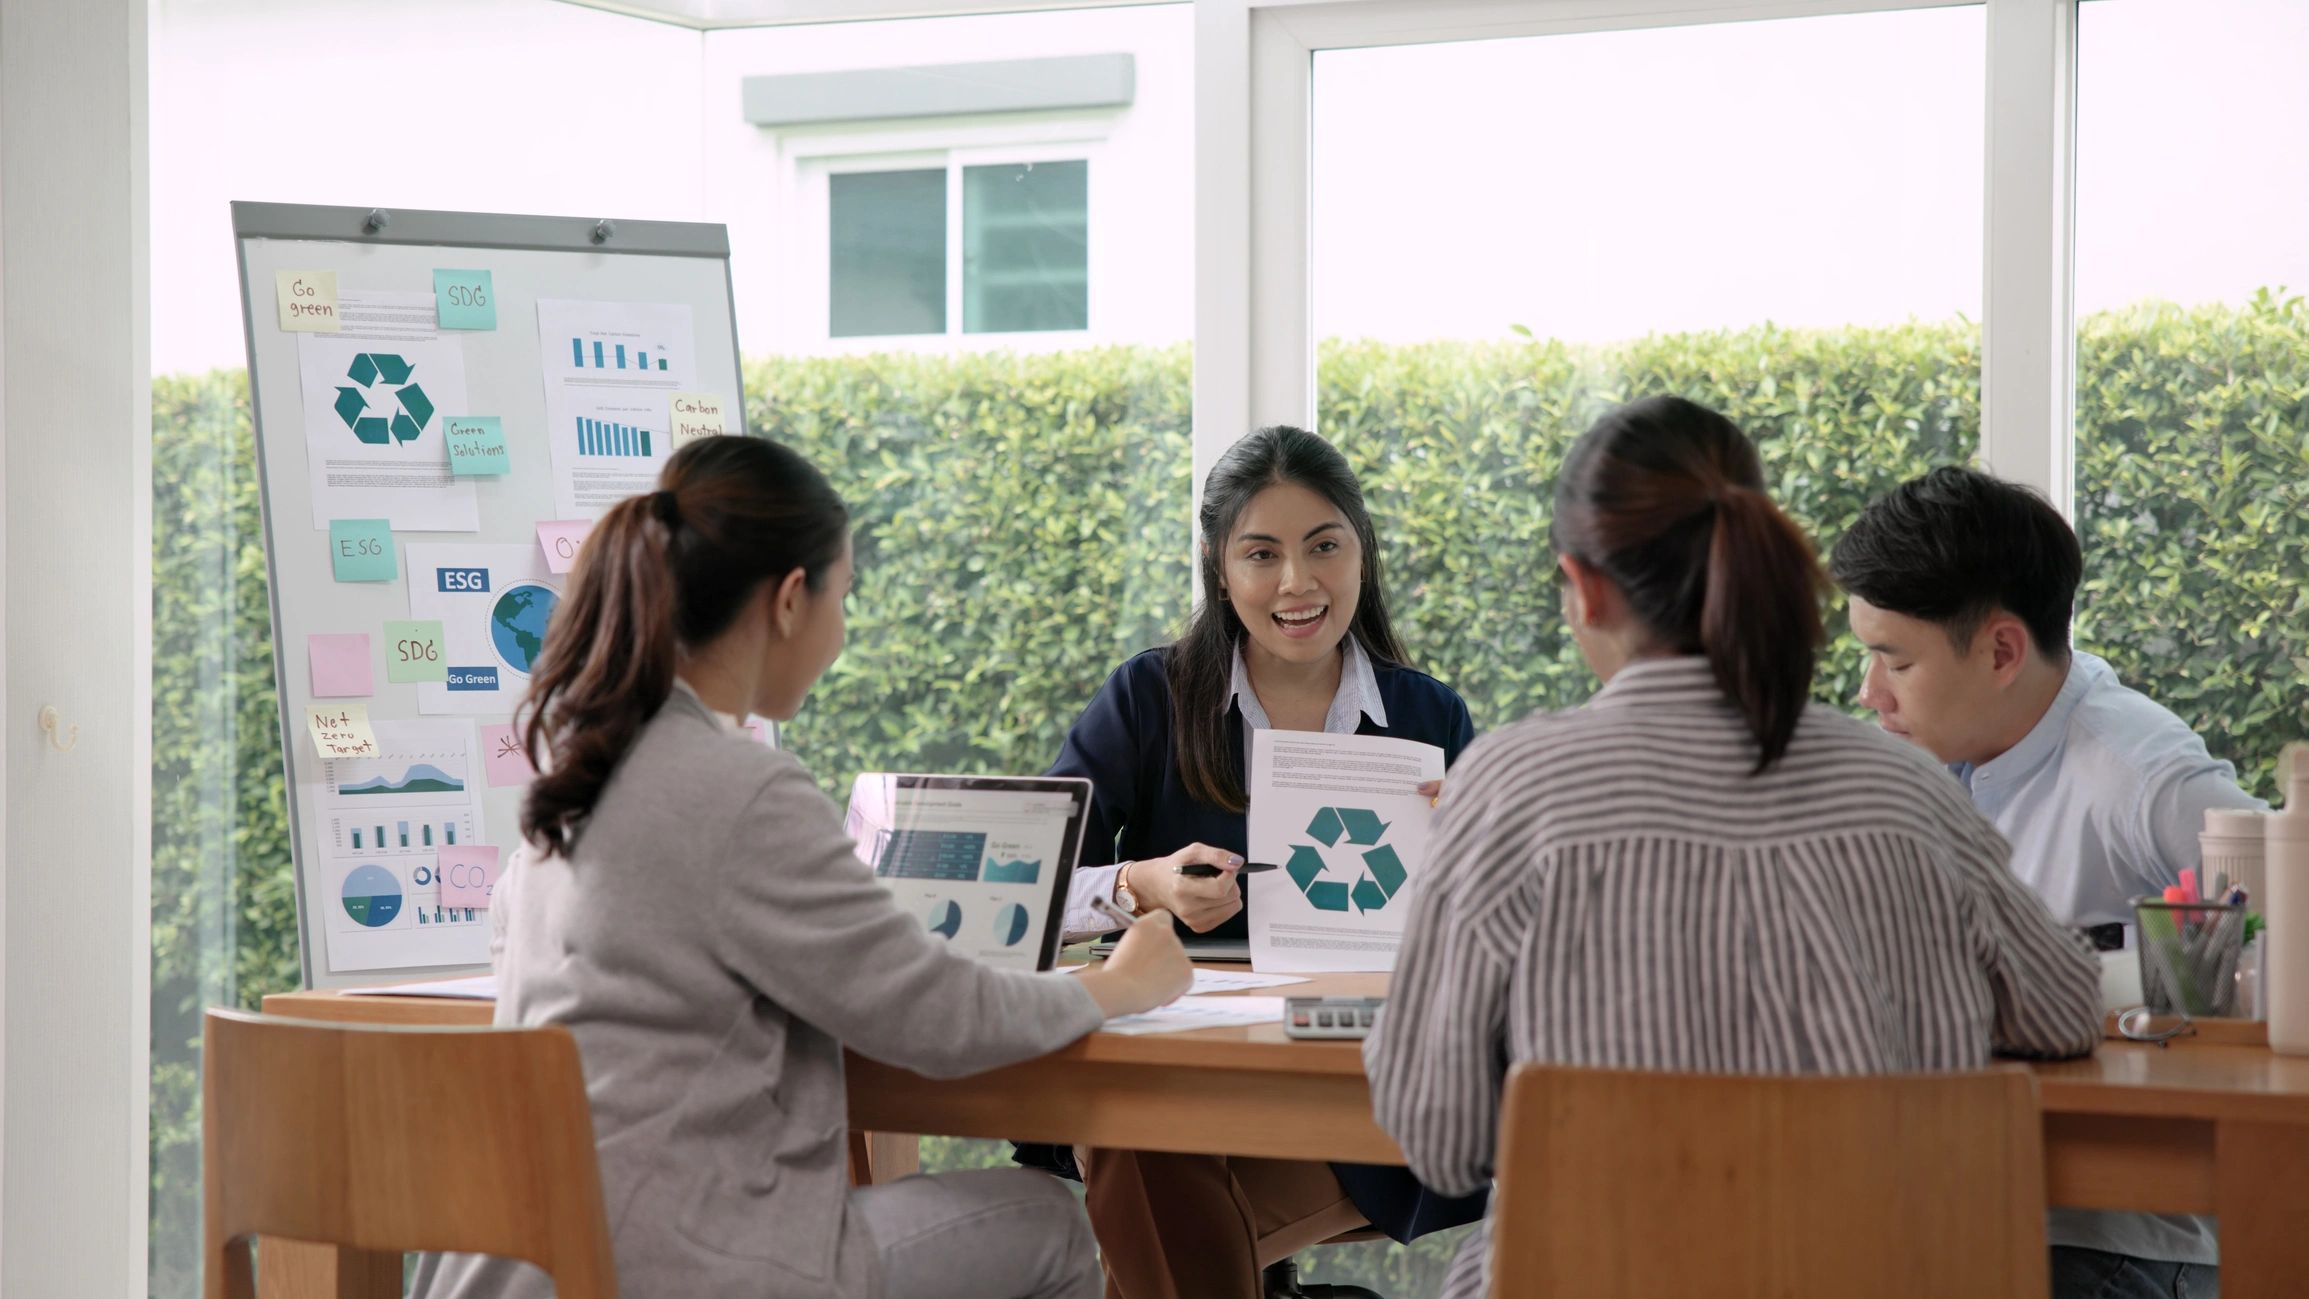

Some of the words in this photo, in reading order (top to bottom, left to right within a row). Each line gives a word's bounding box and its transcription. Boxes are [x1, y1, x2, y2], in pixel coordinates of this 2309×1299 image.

[292, 279, 315, 297] Go
[448, 285, 486, 307] SDG
[290, 302, 333, 318] green
[675, 398, 719, 415] Carbon
[450, 421, 485, 436] Green
[340, 538, 383, 557] ESG
[444, 571, 483, 590] ESG
[397, 639, 439, 662] SDG
[448, 674, 464, 684] Go
[465, 674, 496, 684] Green
[315, 711, 350, 729] Net
[326, 739, 372, 755] Target
